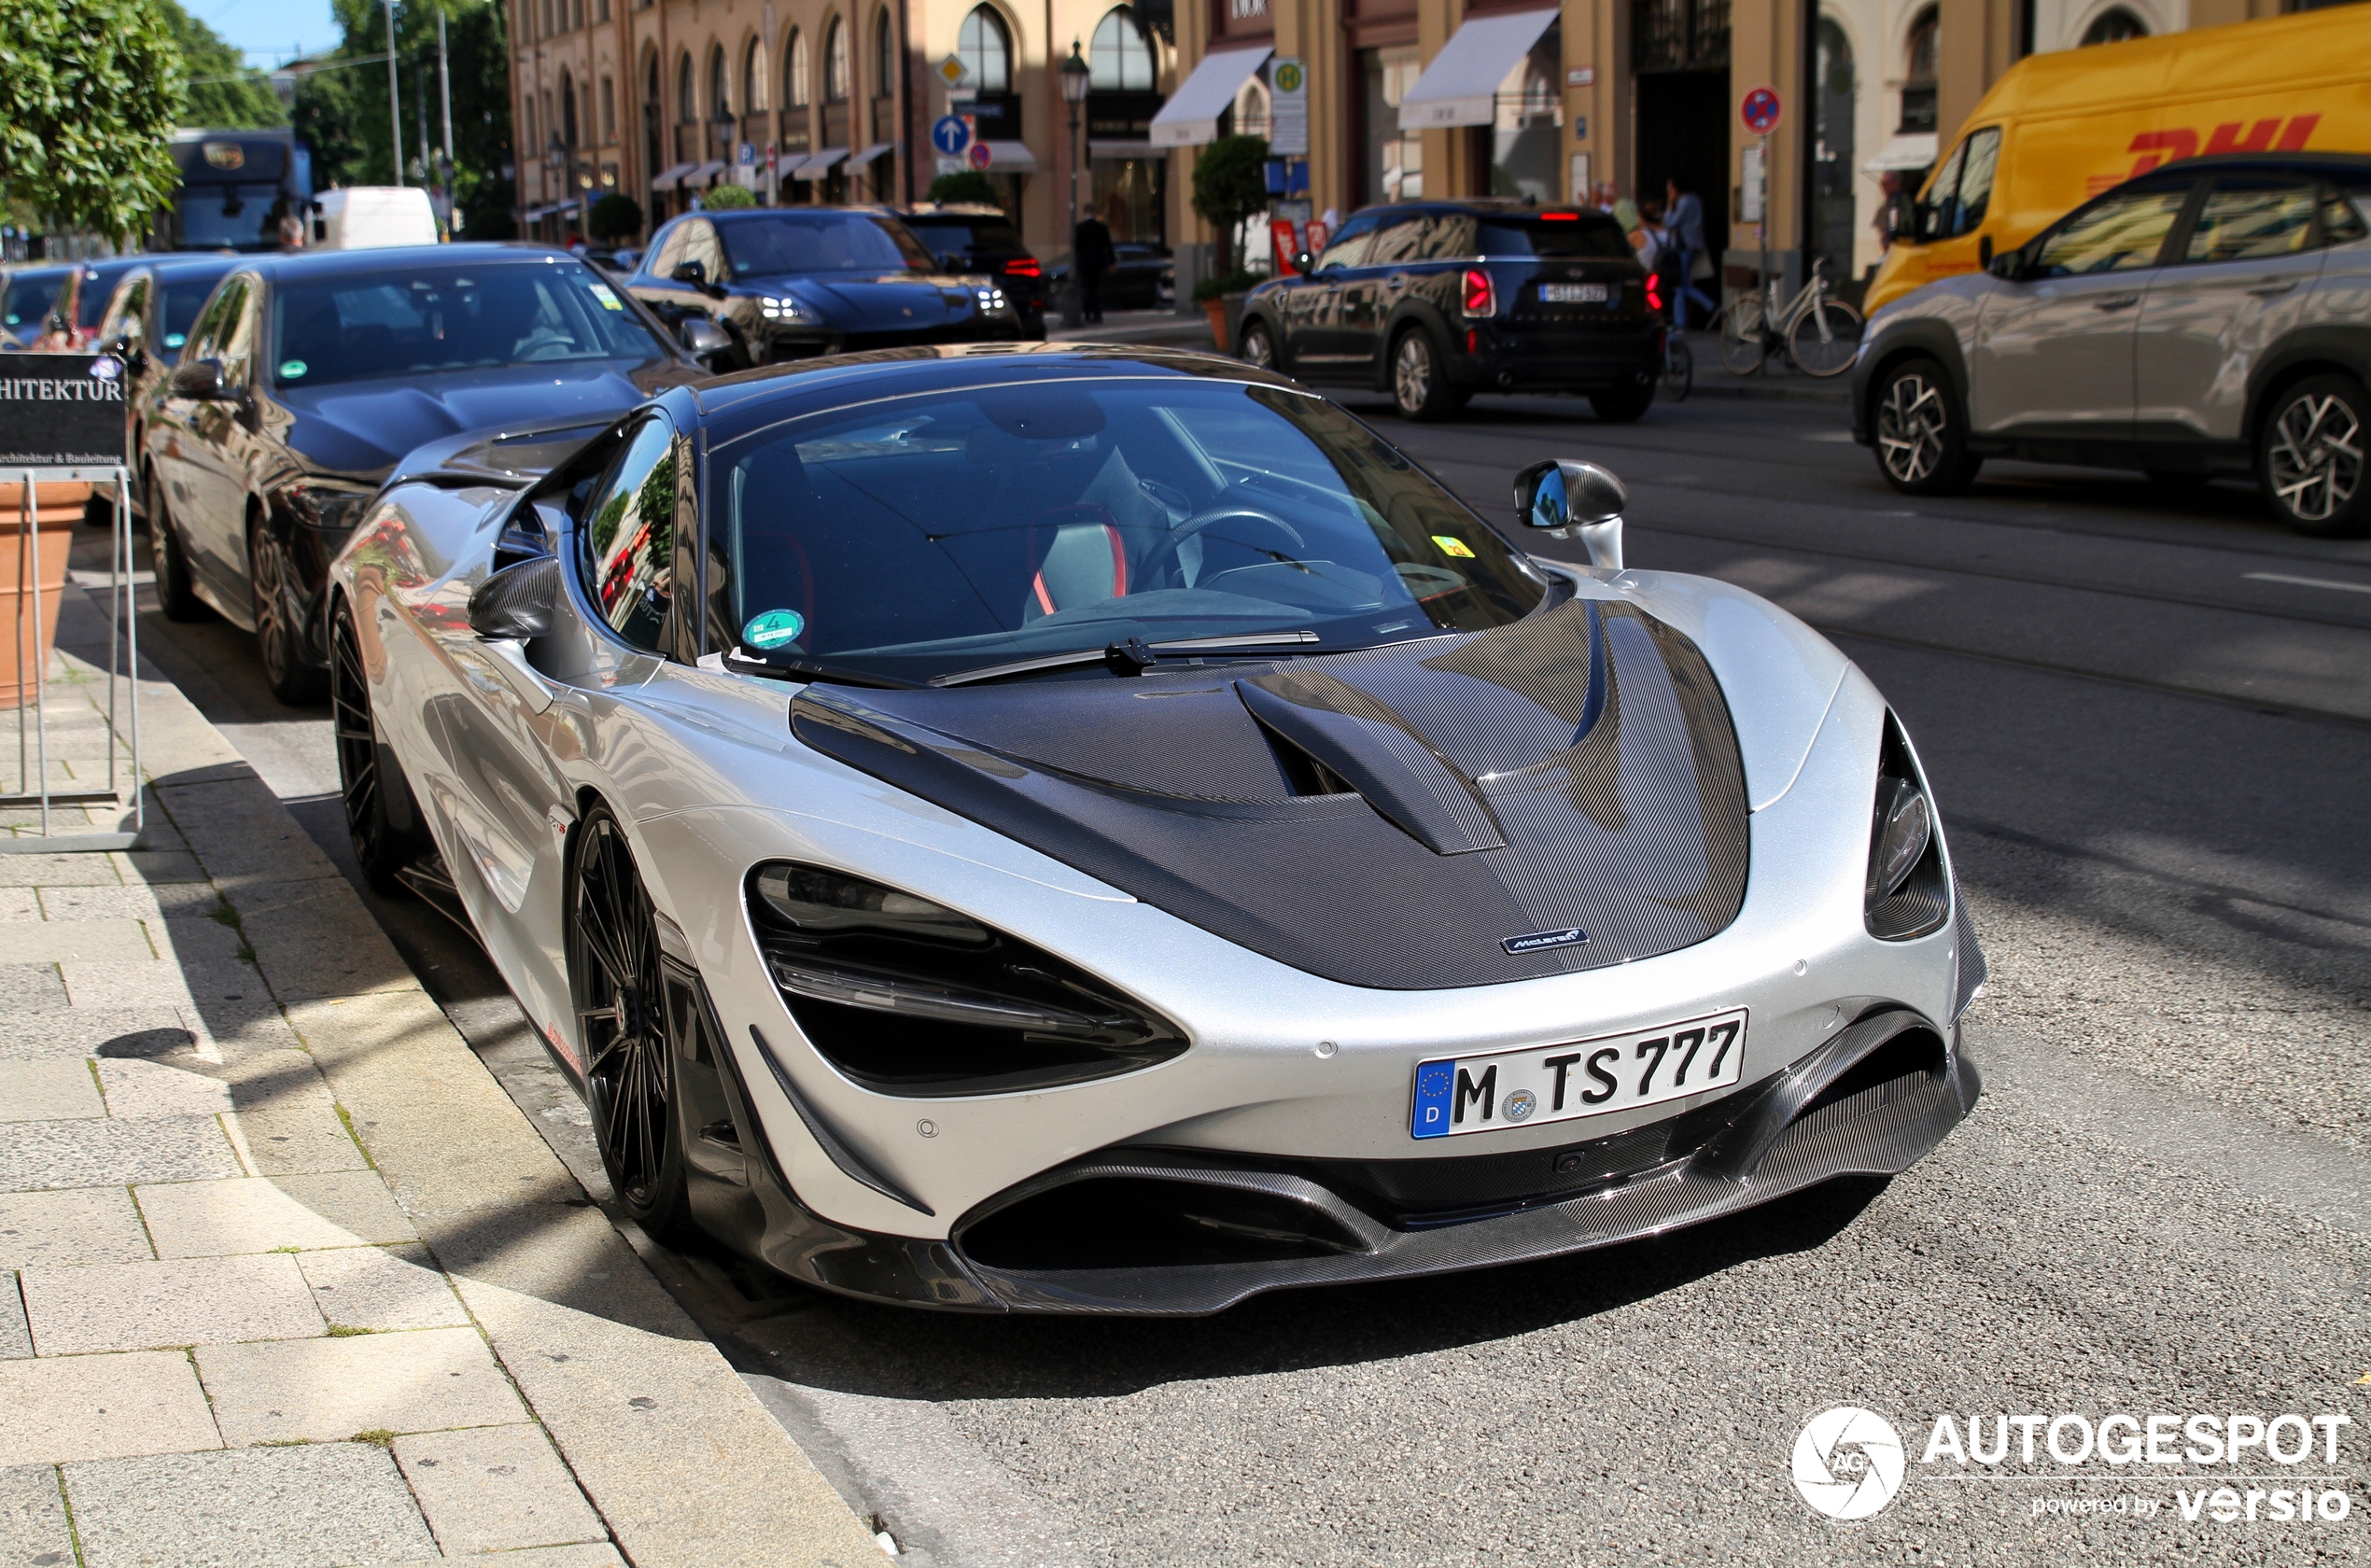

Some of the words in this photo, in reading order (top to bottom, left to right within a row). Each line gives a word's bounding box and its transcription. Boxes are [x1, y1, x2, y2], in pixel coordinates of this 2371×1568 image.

[54, 452, 64, 464] &
[65, 452, 122, 466] Bauleitung
[765, 615, 780, 629] 4
[1514, 931, 1579, 948] McLaren
[1425, 1107, 1439, 1123] D
[1454, 1064, 1497, 1123] M
